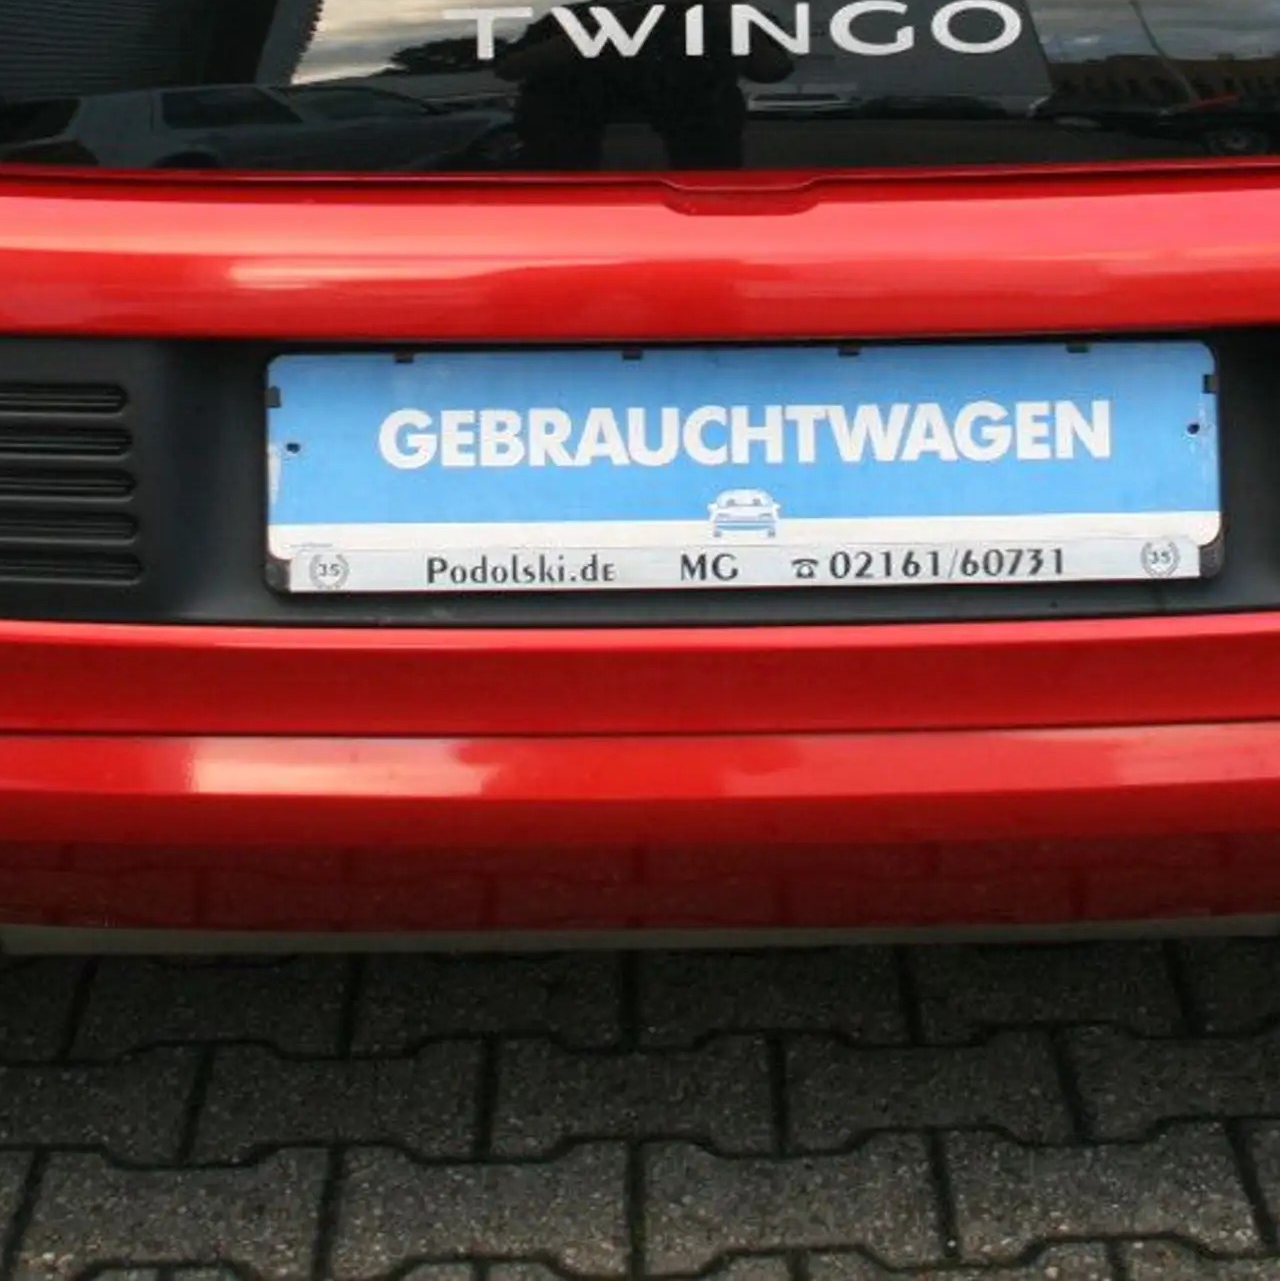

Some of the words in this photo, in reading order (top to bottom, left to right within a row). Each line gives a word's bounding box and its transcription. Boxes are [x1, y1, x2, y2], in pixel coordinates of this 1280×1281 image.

[378, 400, 1111, 470] GEBRAUCHTWAGEN
[679, 553, 740, 583] MG
[829, 547, 1065, 580] 02161/60731
